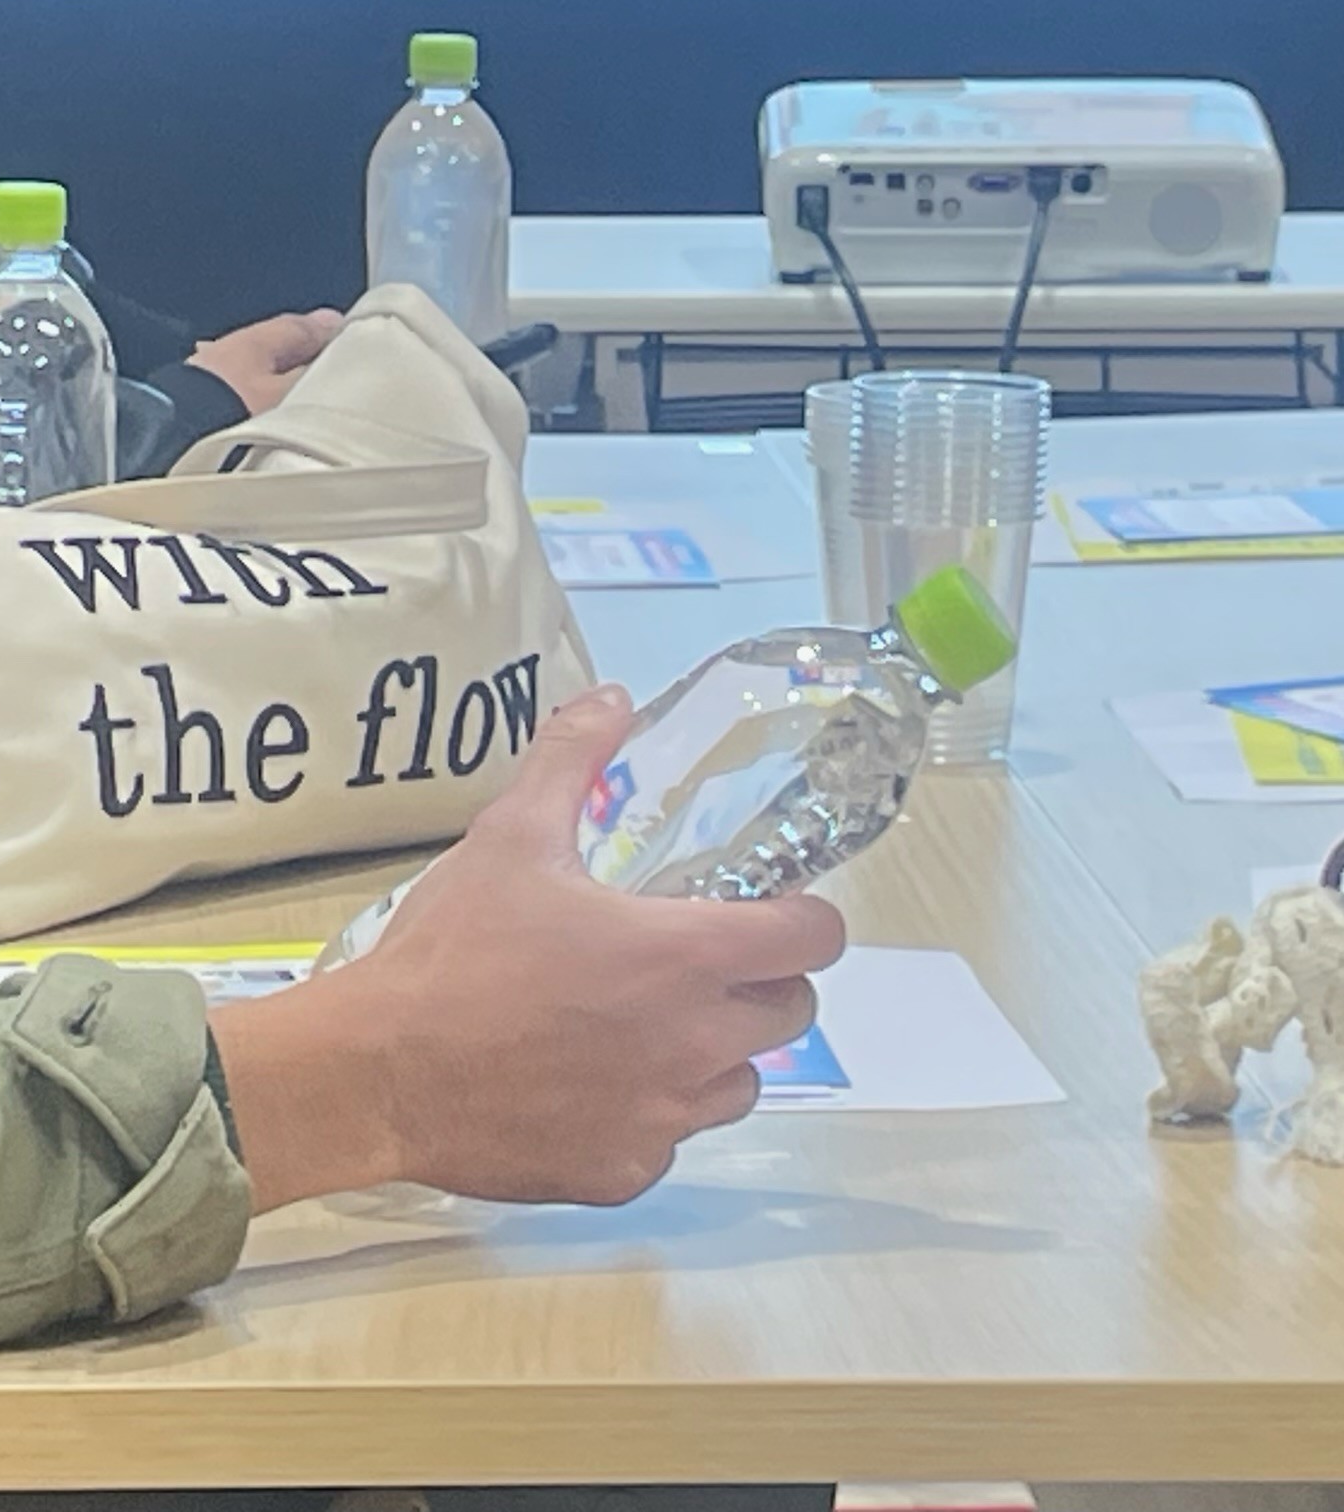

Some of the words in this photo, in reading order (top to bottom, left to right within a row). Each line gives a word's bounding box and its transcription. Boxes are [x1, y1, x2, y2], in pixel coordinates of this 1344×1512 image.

[19, 532, 388, 614] with
[79, 662, 309, 817] the
[346, 653, 540, 787] flow
